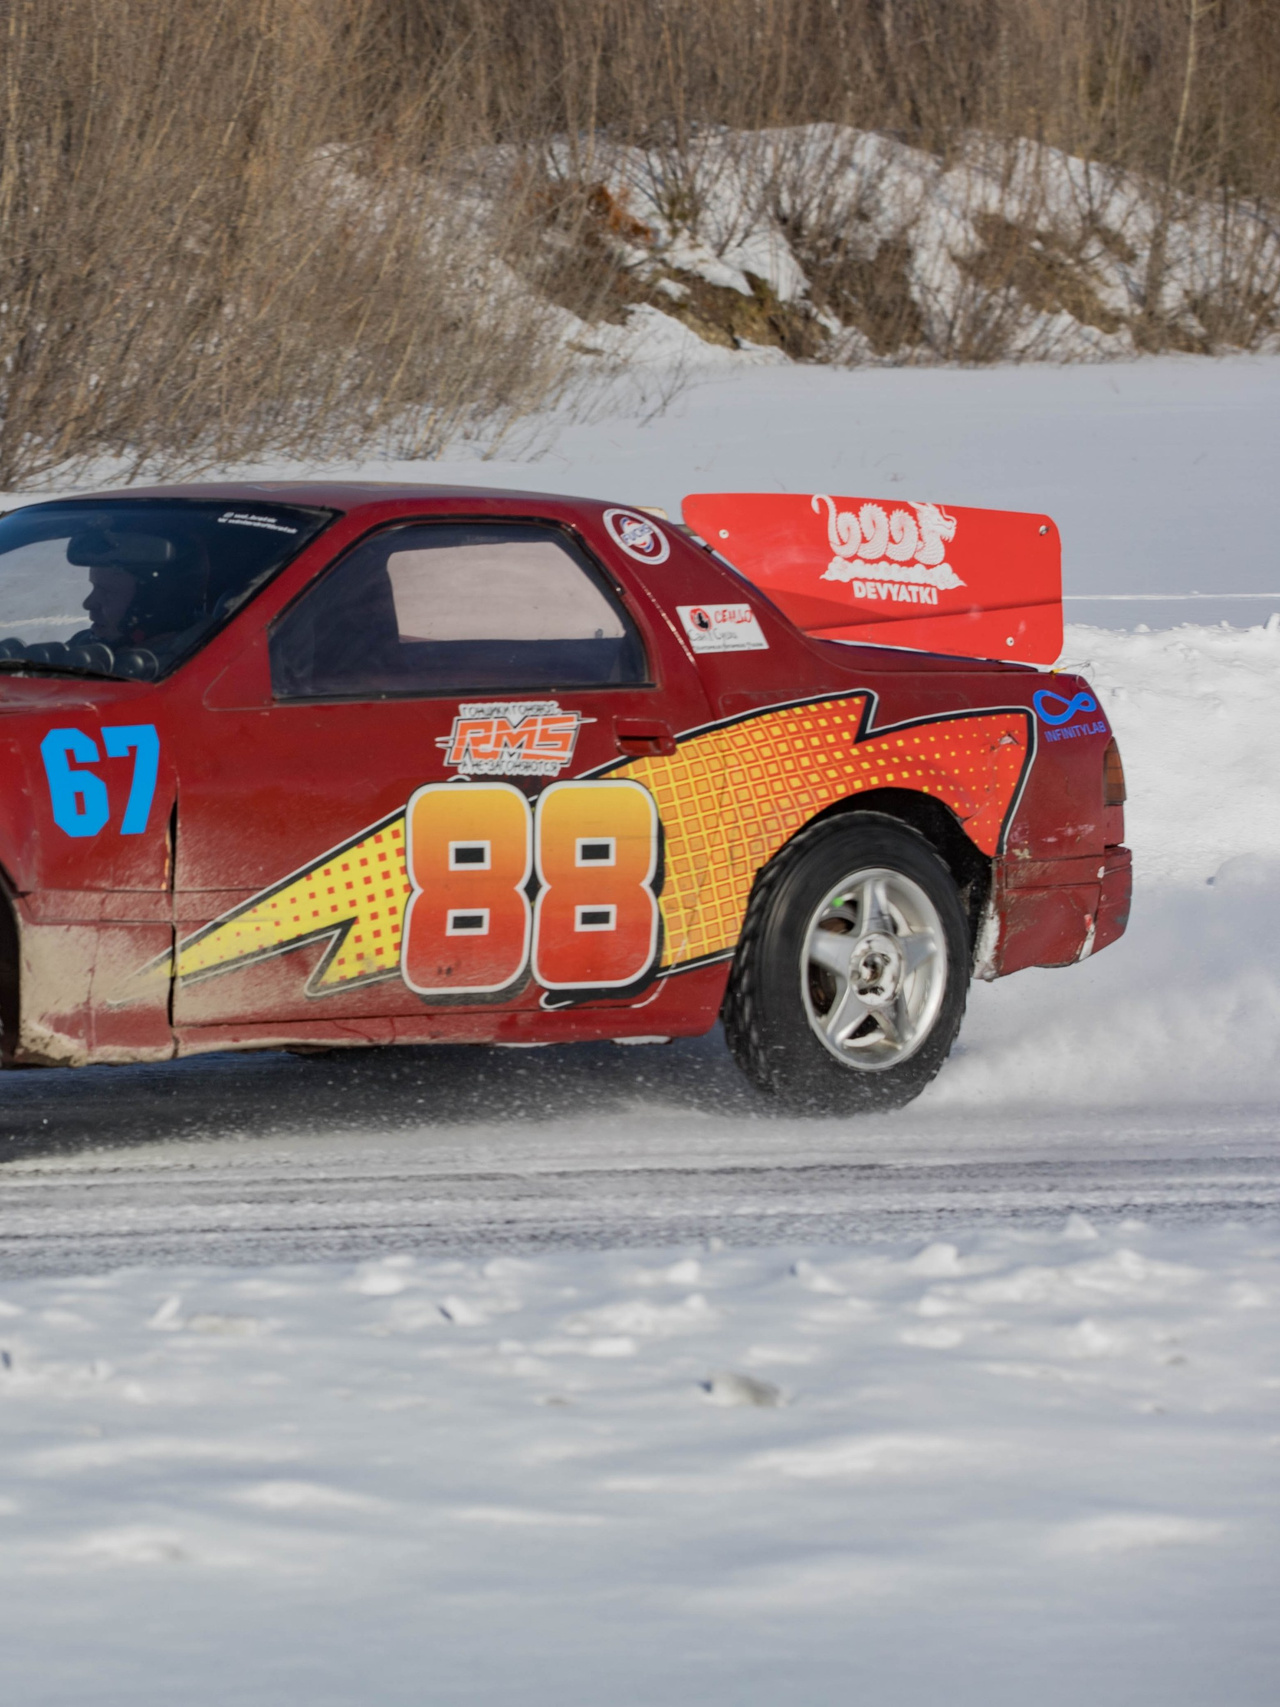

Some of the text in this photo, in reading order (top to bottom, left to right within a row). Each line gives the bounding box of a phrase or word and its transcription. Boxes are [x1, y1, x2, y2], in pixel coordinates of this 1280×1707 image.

[853, 580, 938, 605] DEVYATKI
[451, 715, 578, 762] RMS
[1044, 721, 1106, 742] INFINITYLAB
[40, 724, 160, 838] 67
[400, 778, 660, 997] 88
